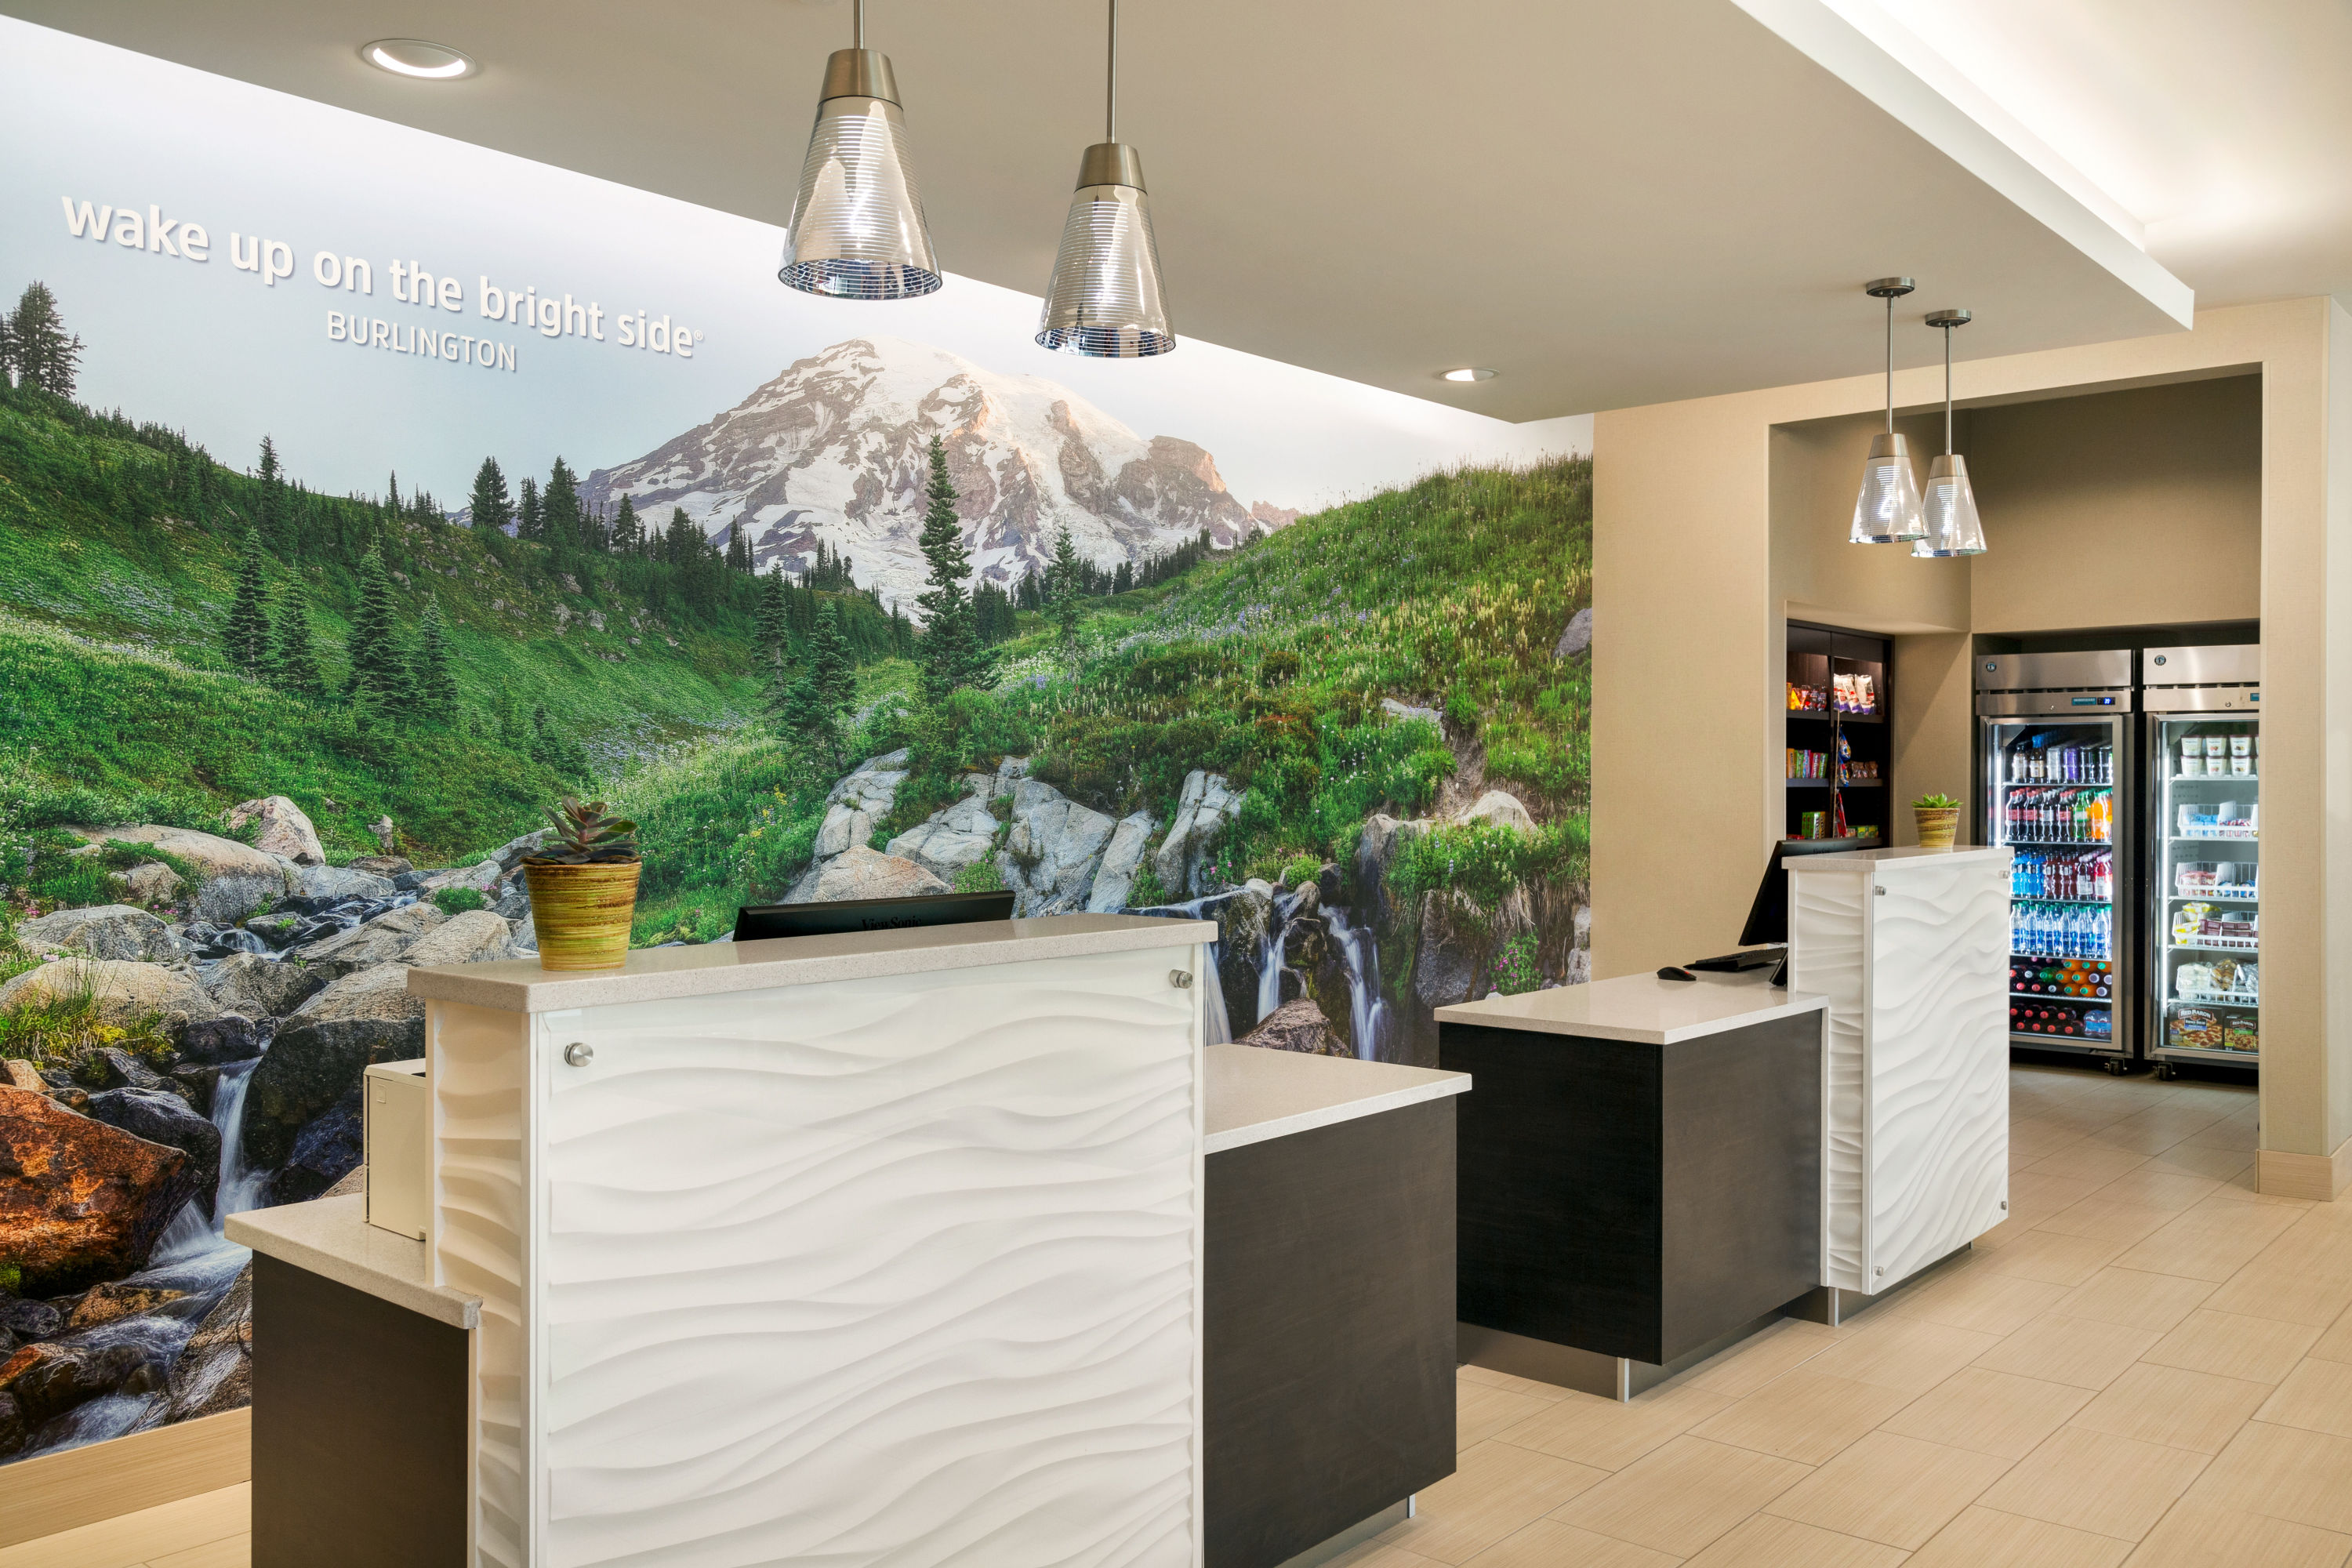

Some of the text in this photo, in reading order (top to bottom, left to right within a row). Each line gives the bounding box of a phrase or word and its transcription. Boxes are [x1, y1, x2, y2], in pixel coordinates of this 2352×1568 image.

[61, 196, 209, 261] wake
[230, 232, 295, 285] up
[313, 250, 372, 294] on
[389, 259, 463, 311] the
[479, 275, 605, 340] bright
[327, 310, 517, 372] BURLINGTON
[2192, 1009, 2211, 1018] BARON
